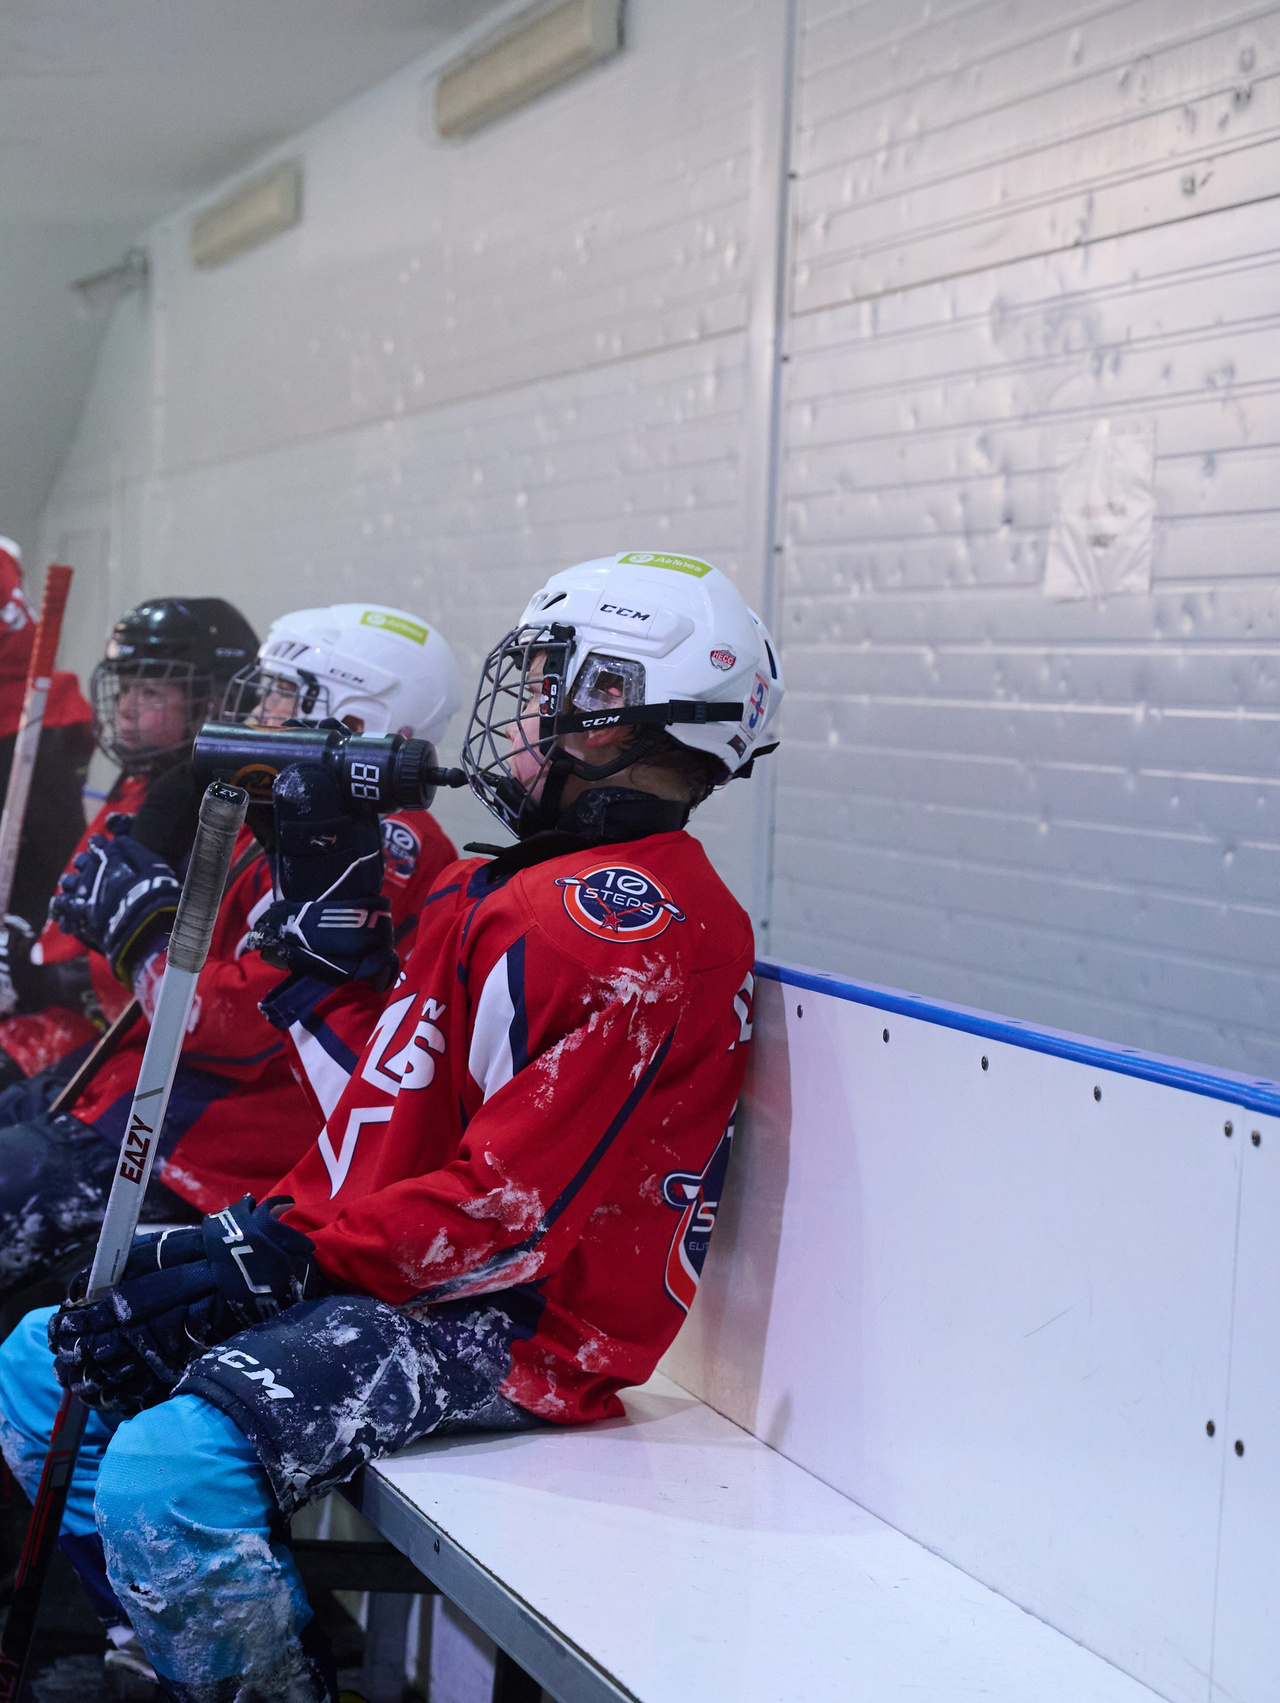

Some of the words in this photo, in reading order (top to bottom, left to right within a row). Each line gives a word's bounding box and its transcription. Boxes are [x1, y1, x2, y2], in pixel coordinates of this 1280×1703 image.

[655, 557, 703, 572] Airlines
[600, 603, 651, 621] CCM
[581, 715, 621, 728] CCM
[350, 761, 381, 801] 88
[385, 822, 414, 851] 10
[605, 870, 648, 896] 10
[583, 887, 655, 916] STEPS
[120, 1115, 157, 1185] EAZY
